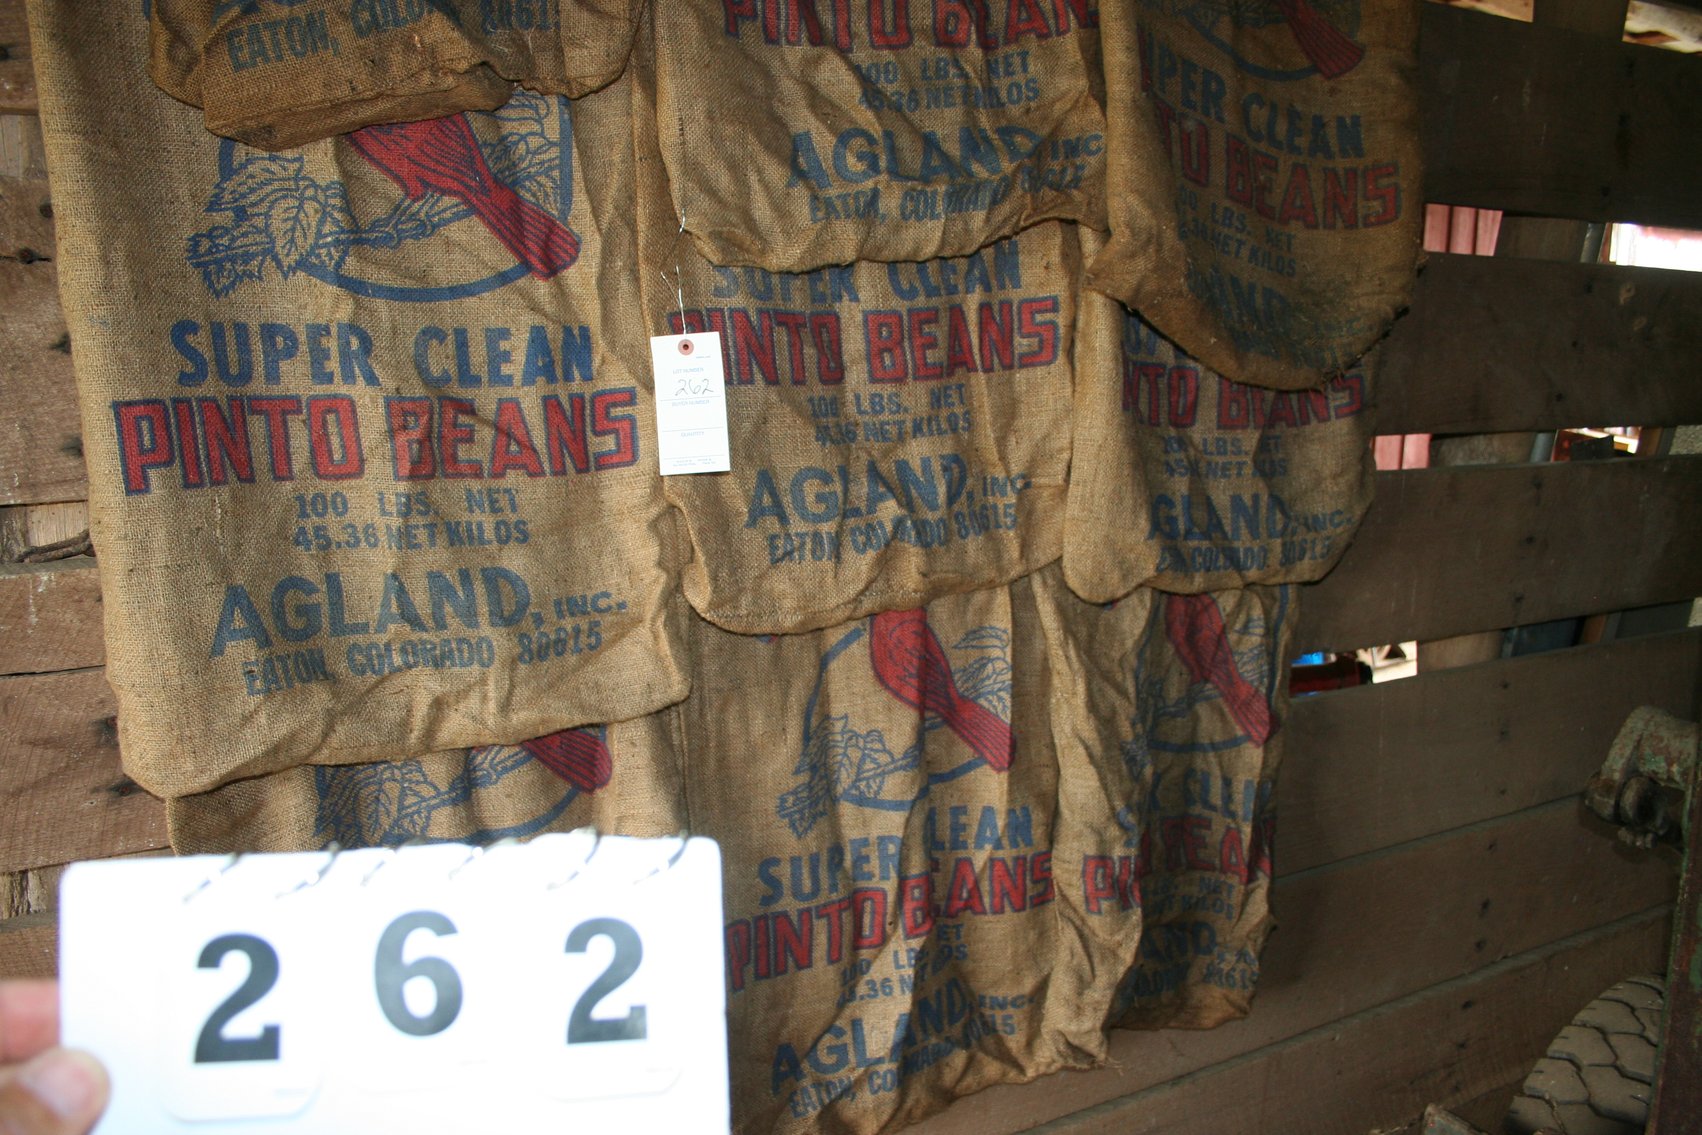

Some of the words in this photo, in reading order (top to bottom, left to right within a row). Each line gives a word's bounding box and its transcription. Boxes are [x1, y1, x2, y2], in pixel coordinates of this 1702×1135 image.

[1242, 92, 1366, 160] CLEAN
[1225, 131, 1402, 230] BEANS
[886, 238, 1023, 301] CLEAN
[170, 319, 381, 391] SUPER
[414, 324, 595, 391] CLEAN
[862, 295, 1061, 386] BEANS
[674, 377, 715, 397] 262
[854, 391, 909, 416] LBS.
[930, 383, 966, 410] NET
[111, 393, 366, 498] PINTO
[382, 385, 641, 484] BEANS
[863, 418, 907, 443] NET
[911, 409, 972, 439] KILOS
[293, 490, 350, 521] 100
[378, 490, 439, 519] LBS.
[465, 487, 520, 516] NET
[293, 521, 380, 553] 45.36
[386, 521, 439, 551] NET
[443, 518, 530, 549] KILOS
[210, 565, 545, 661] AGLAND,
[552, 590, 628, 623] INC.
[346, 634, 496, 679] COLORADO
[757, 834, 903, 907] SUPER
[724, 886, 888, 993] PINTO
